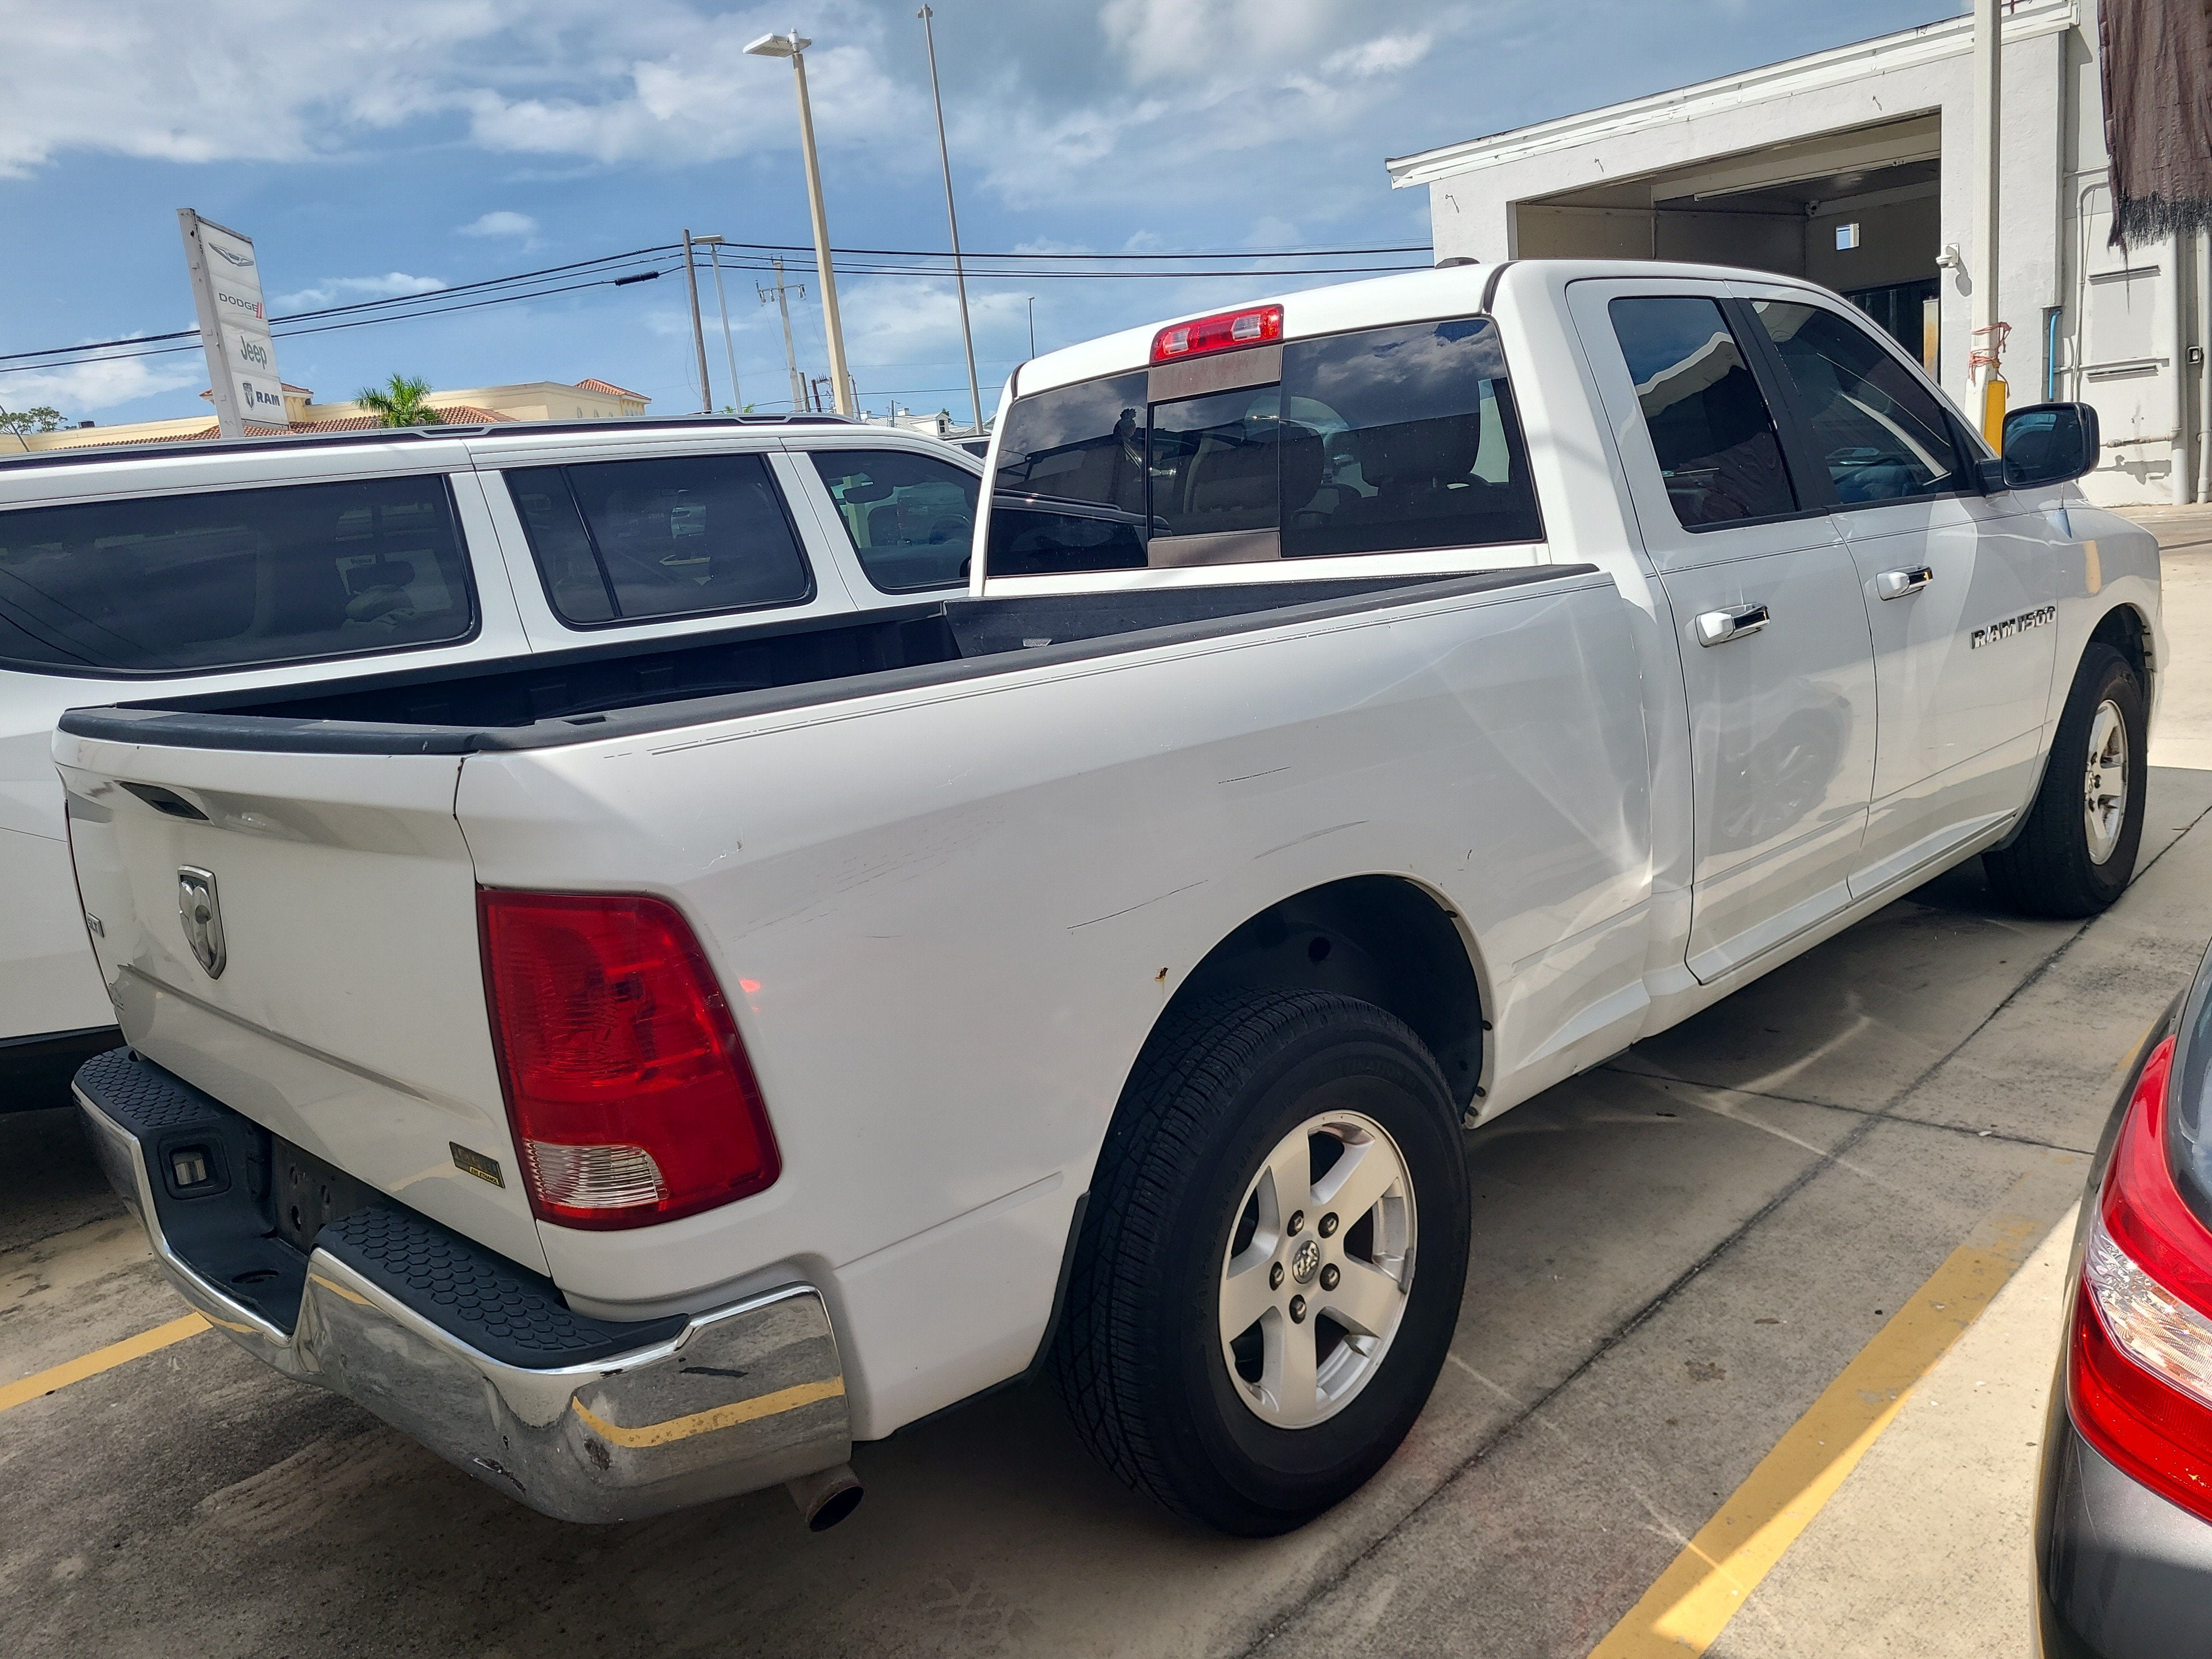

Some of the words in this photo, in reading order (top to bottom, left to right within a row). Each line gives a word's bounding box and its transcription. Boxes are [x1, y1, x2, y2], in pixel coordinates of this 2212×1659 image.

[218, 292, 258, 312] DODGE
[240, 335, 267, 370] Jeep
[256, 391, 280, 406] RAM
[1971, 618, 2016, 649] RAM
[2017, 606, 2056, 632] 1500
